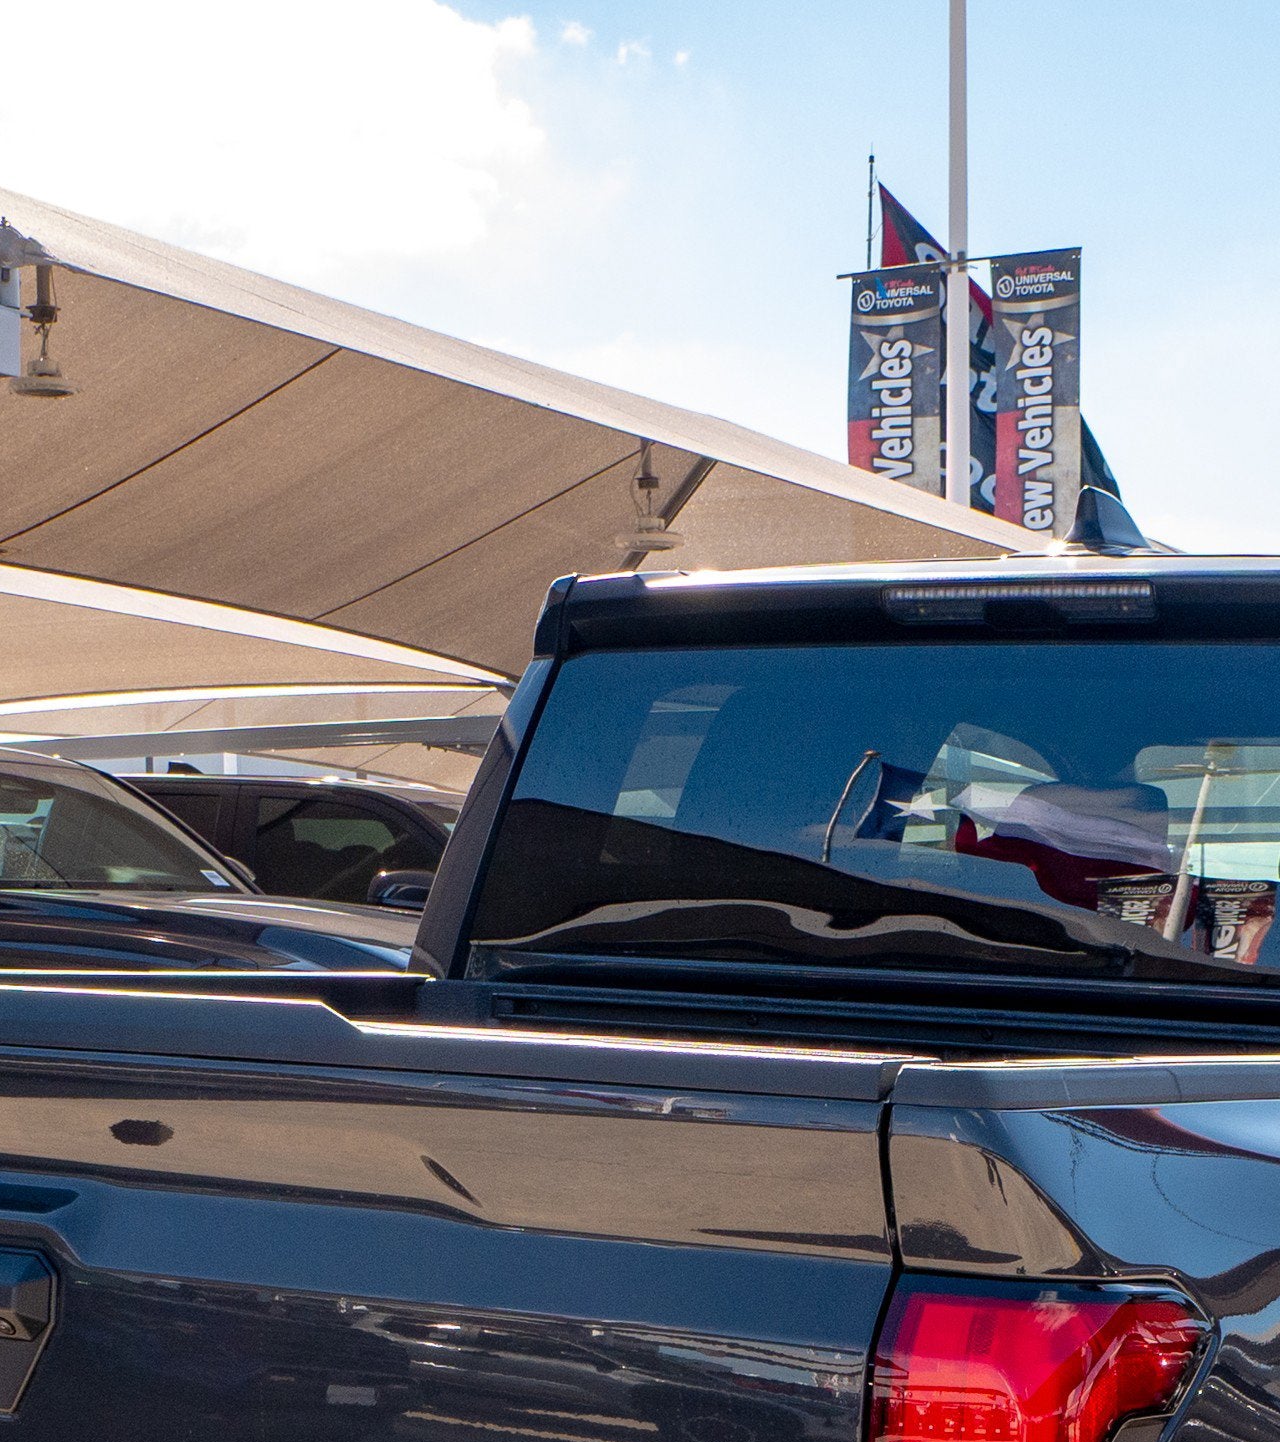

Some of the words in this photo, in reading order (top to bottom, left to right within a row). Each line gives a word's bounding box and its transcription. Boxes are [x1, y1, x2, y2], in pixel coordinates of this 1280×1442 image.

[1015, 270, 1075, 286] UNIVERSAL
[1015, 283, 1055, 296] TOYOTA
[875, 297, 915, 310] TOYOTA
[872, 339, 913, 480] Vehicles
[1017, 327, 1054, 475] Vehicles
[1023, 480, 1054, 531] ew
